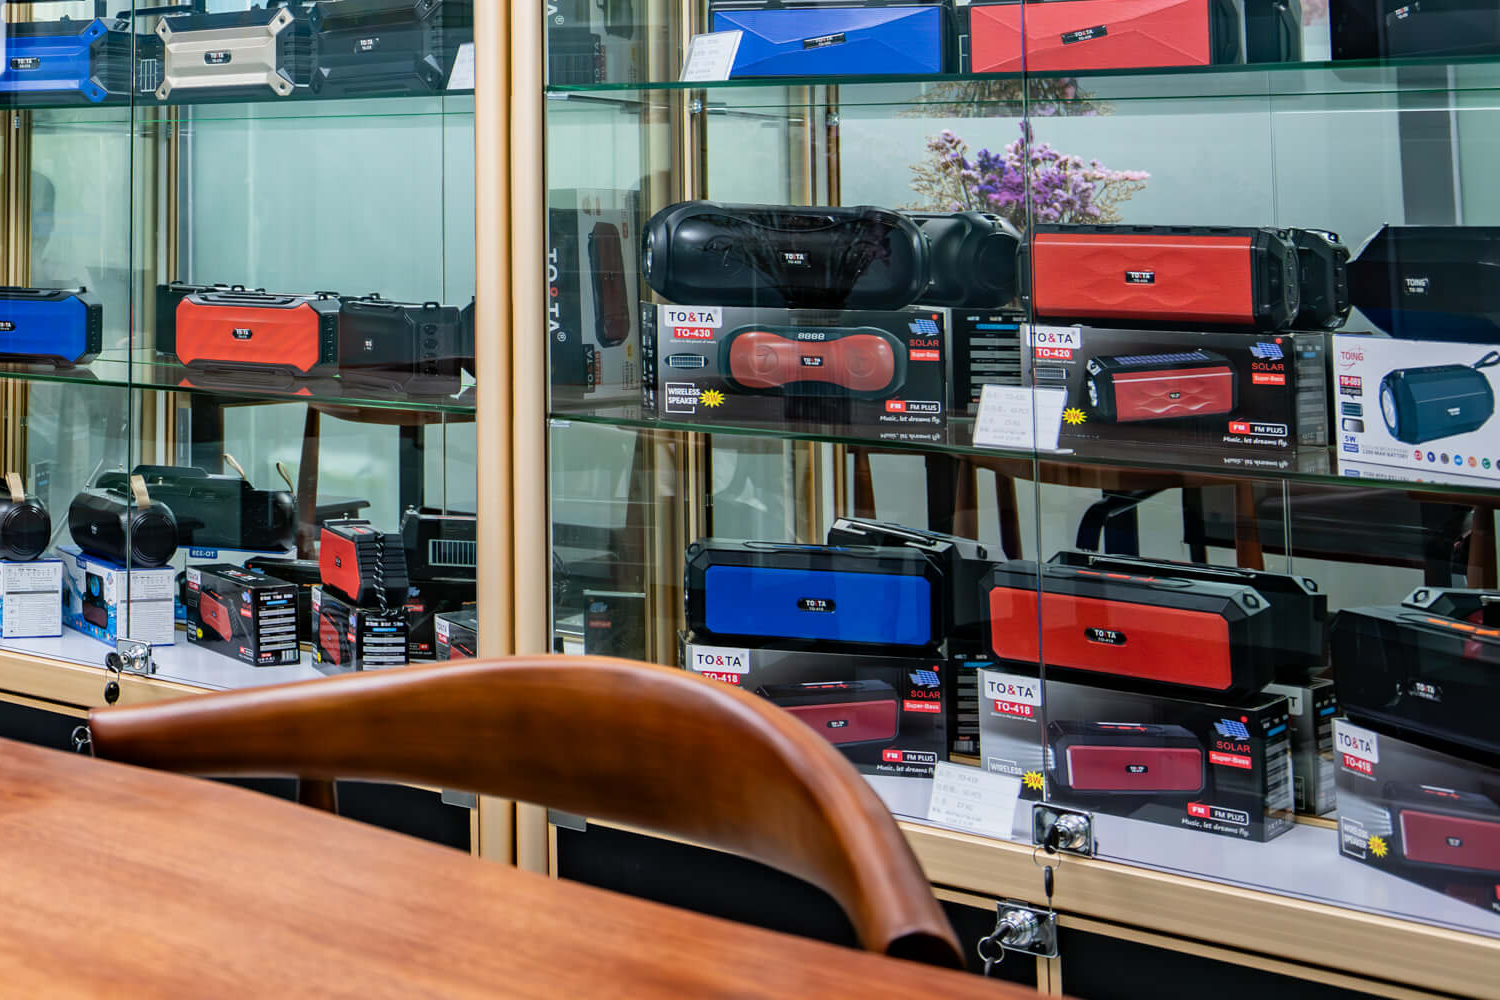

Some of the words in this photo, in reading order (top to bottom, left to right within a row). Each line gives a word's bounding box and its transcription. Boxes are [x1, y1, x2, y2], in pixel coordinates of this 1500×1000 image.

[668, 312, 714, 322] TO&TA
[676, 329, 710, 337] TO-430
[909, 339, 939, 347] SOLAR
[1037, 349, 1070, 358] TO-420
[1340, 351, 1364, 361] TOING
[1252, 362, 1284, 371] SOLAR
[668, 388, 700, 396] WIRELESS
[668, 397, 698, 405] SPEAKER
[697, 654, 742, 667] TO&TA
[910, 689, 940, 698] SOLAR
[988, 681, 1034, 698] TO&TA
[906, 702, 939, 710] Super-Bass
[996, 701, 1031, 715] TO-418
[1216, 740, 1251, 753] SOLAR
[1338, 731, 1372, 753] TO&TA
[1211, 754, 1250, 766] Super-Bass
[1345, 755, 1372, 772] TO-418
[1214, 810, 1226, 819] FM
[1227, 812, 1244, 822] PLUS
[1181, 818, 1202, 828] Music,
[1203, 821, 1212, 830] let
[1213, 822, 1238, 834] dreams
